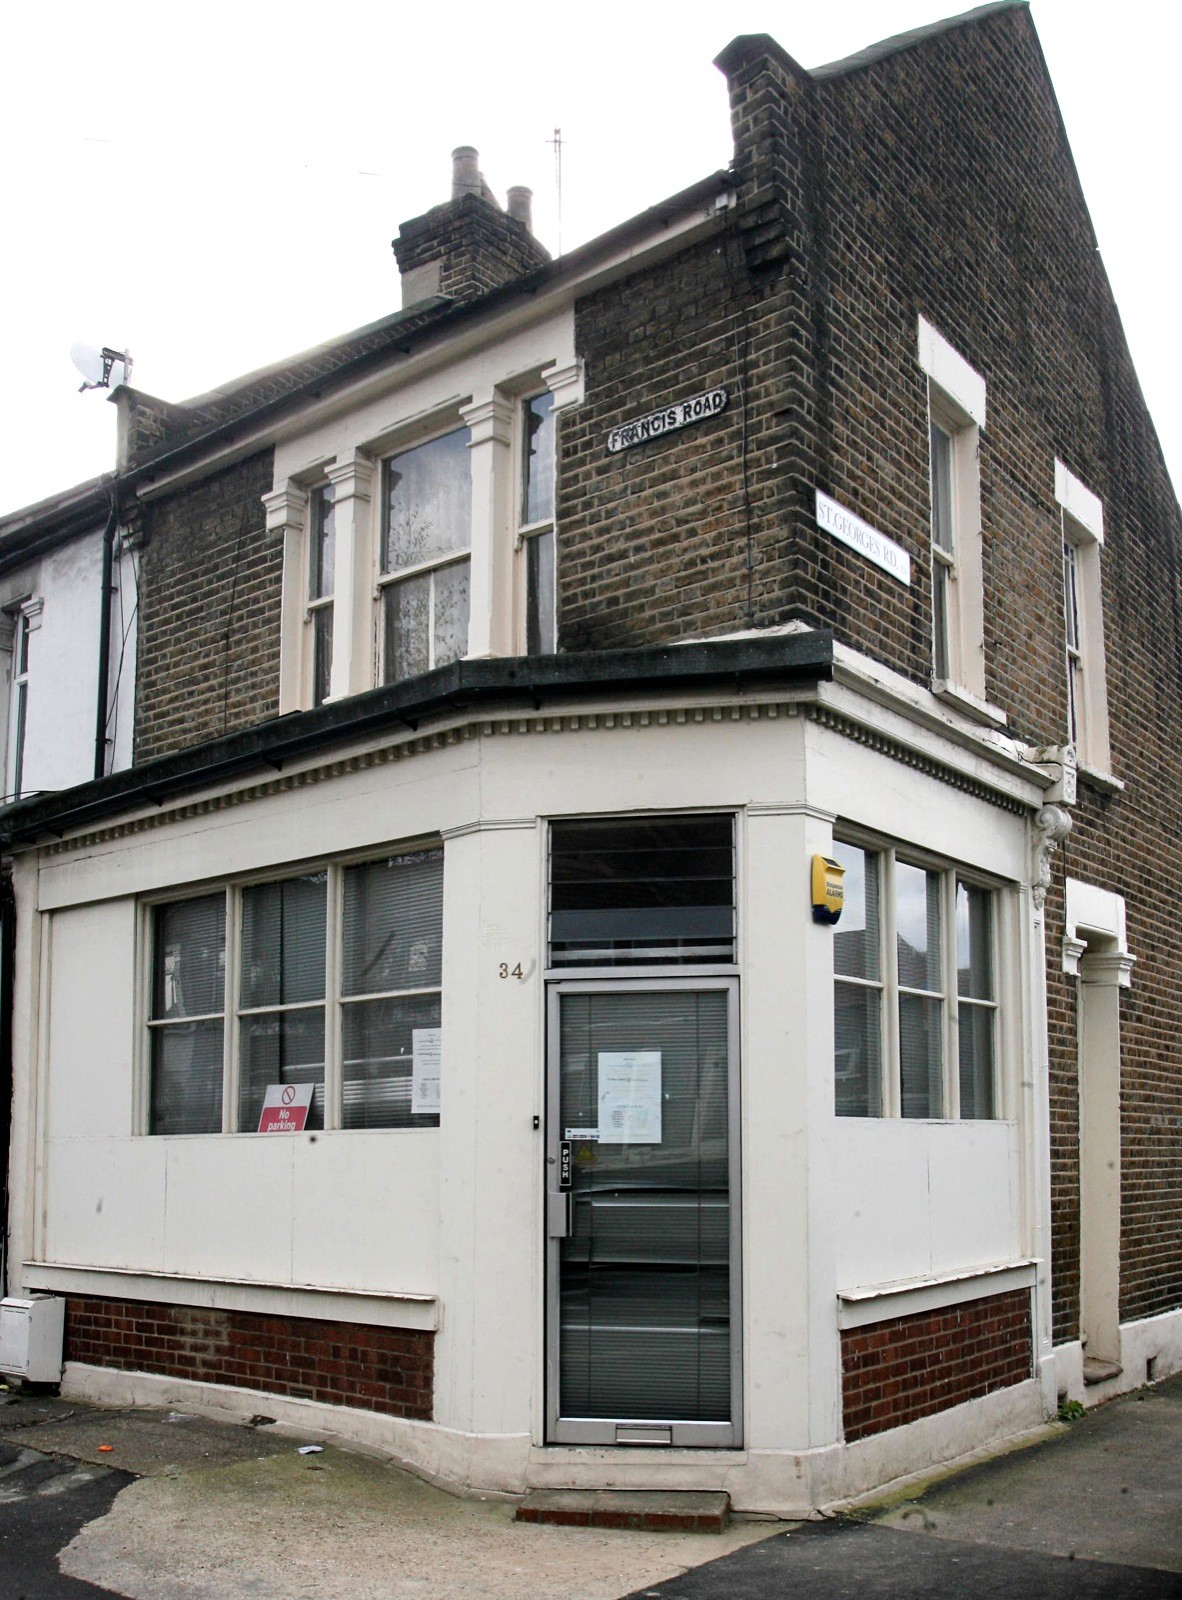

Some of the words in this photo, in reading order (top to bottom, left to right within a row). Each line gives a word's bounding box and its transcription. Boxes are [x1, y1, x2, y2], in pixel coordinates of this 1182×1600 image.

[609, 410, 677, 449] FRANCIS
[682, 392, 722, 421] ROAD
[499, 962, 523, 980] 34
[279, 1109, 290, 1119] No
[268, 1120, 297, 1132] parking
